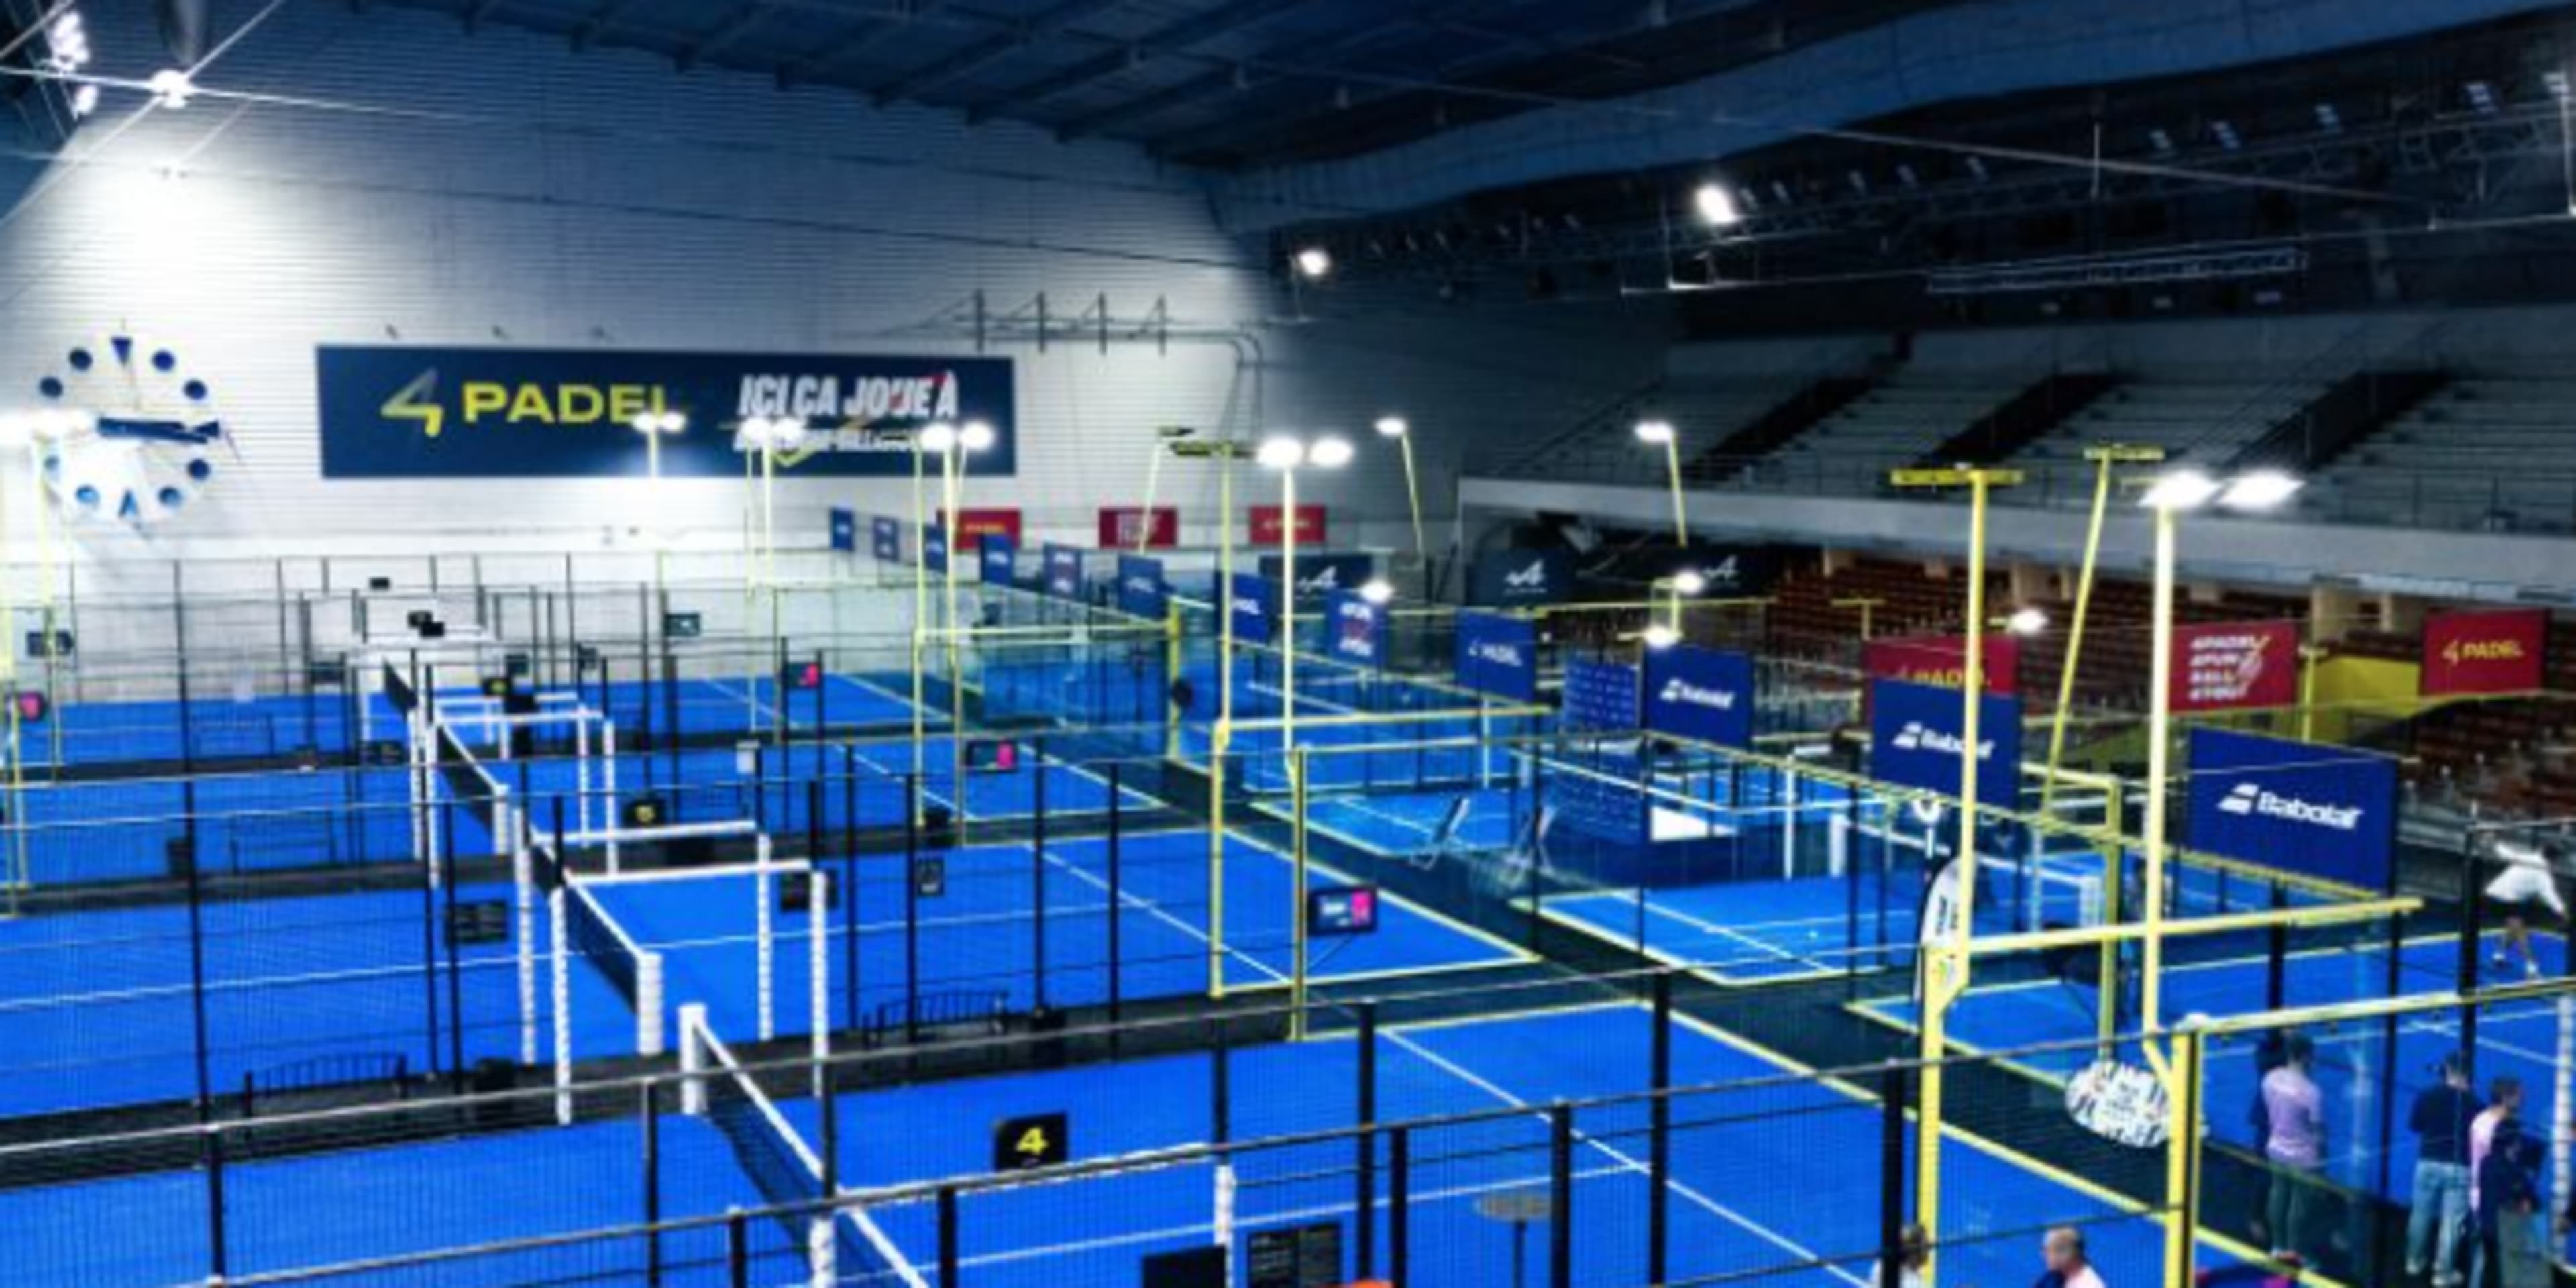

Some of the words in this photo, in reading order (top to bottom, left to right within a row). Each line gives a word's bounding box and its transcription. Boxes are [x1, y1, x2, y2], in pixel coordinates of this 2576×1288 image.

[462, 382, 667, 423] PADEL
[738, 374, 790, 416] ICI
[843, 377, 934, 418] JOUE
[2463, 639, 2525, 659] PADEL
[2256, 790, 2366, 830] Babolat
[1016, 1127, 1049, 1155] 4
